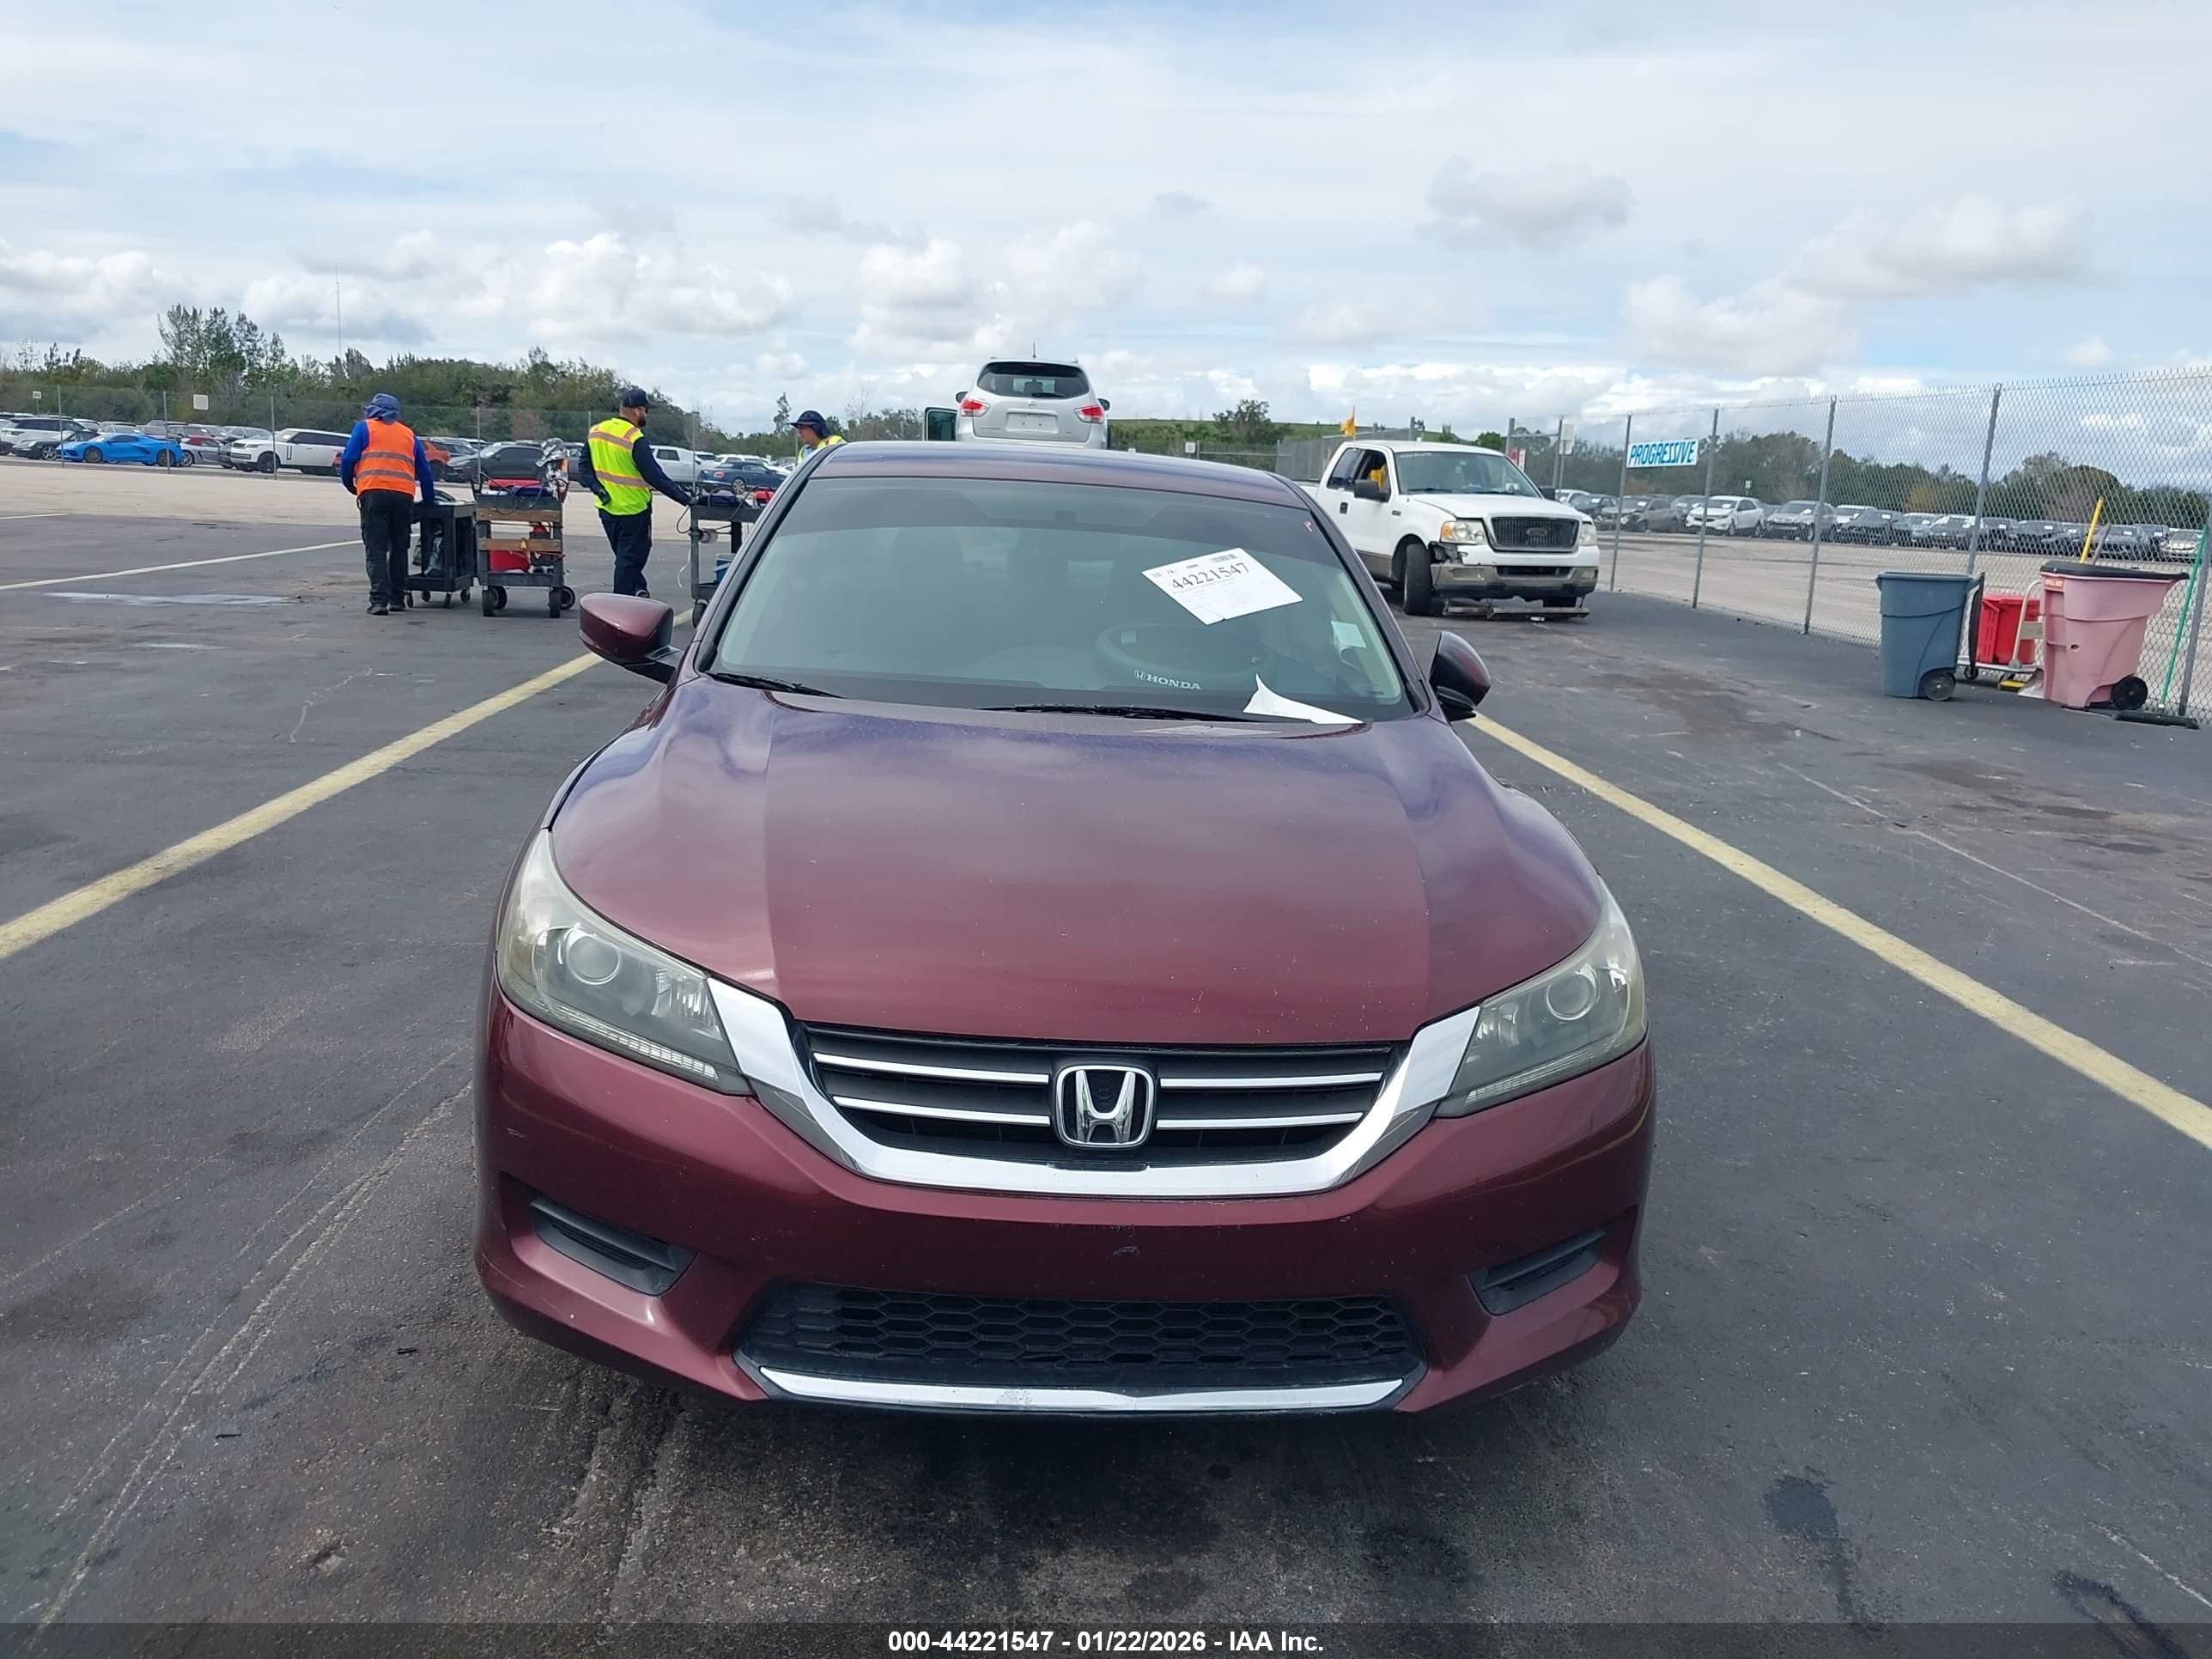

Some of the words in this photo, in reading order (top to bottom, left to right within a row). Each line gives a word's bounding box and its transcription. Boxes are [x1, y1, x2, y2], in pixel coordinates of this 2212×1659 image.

[1629, 441, 1696, 465] PROGRESSIVE
[1172, 562, 1249, 588] 44221547
[1146, 673, 1202, 690] HONDA
